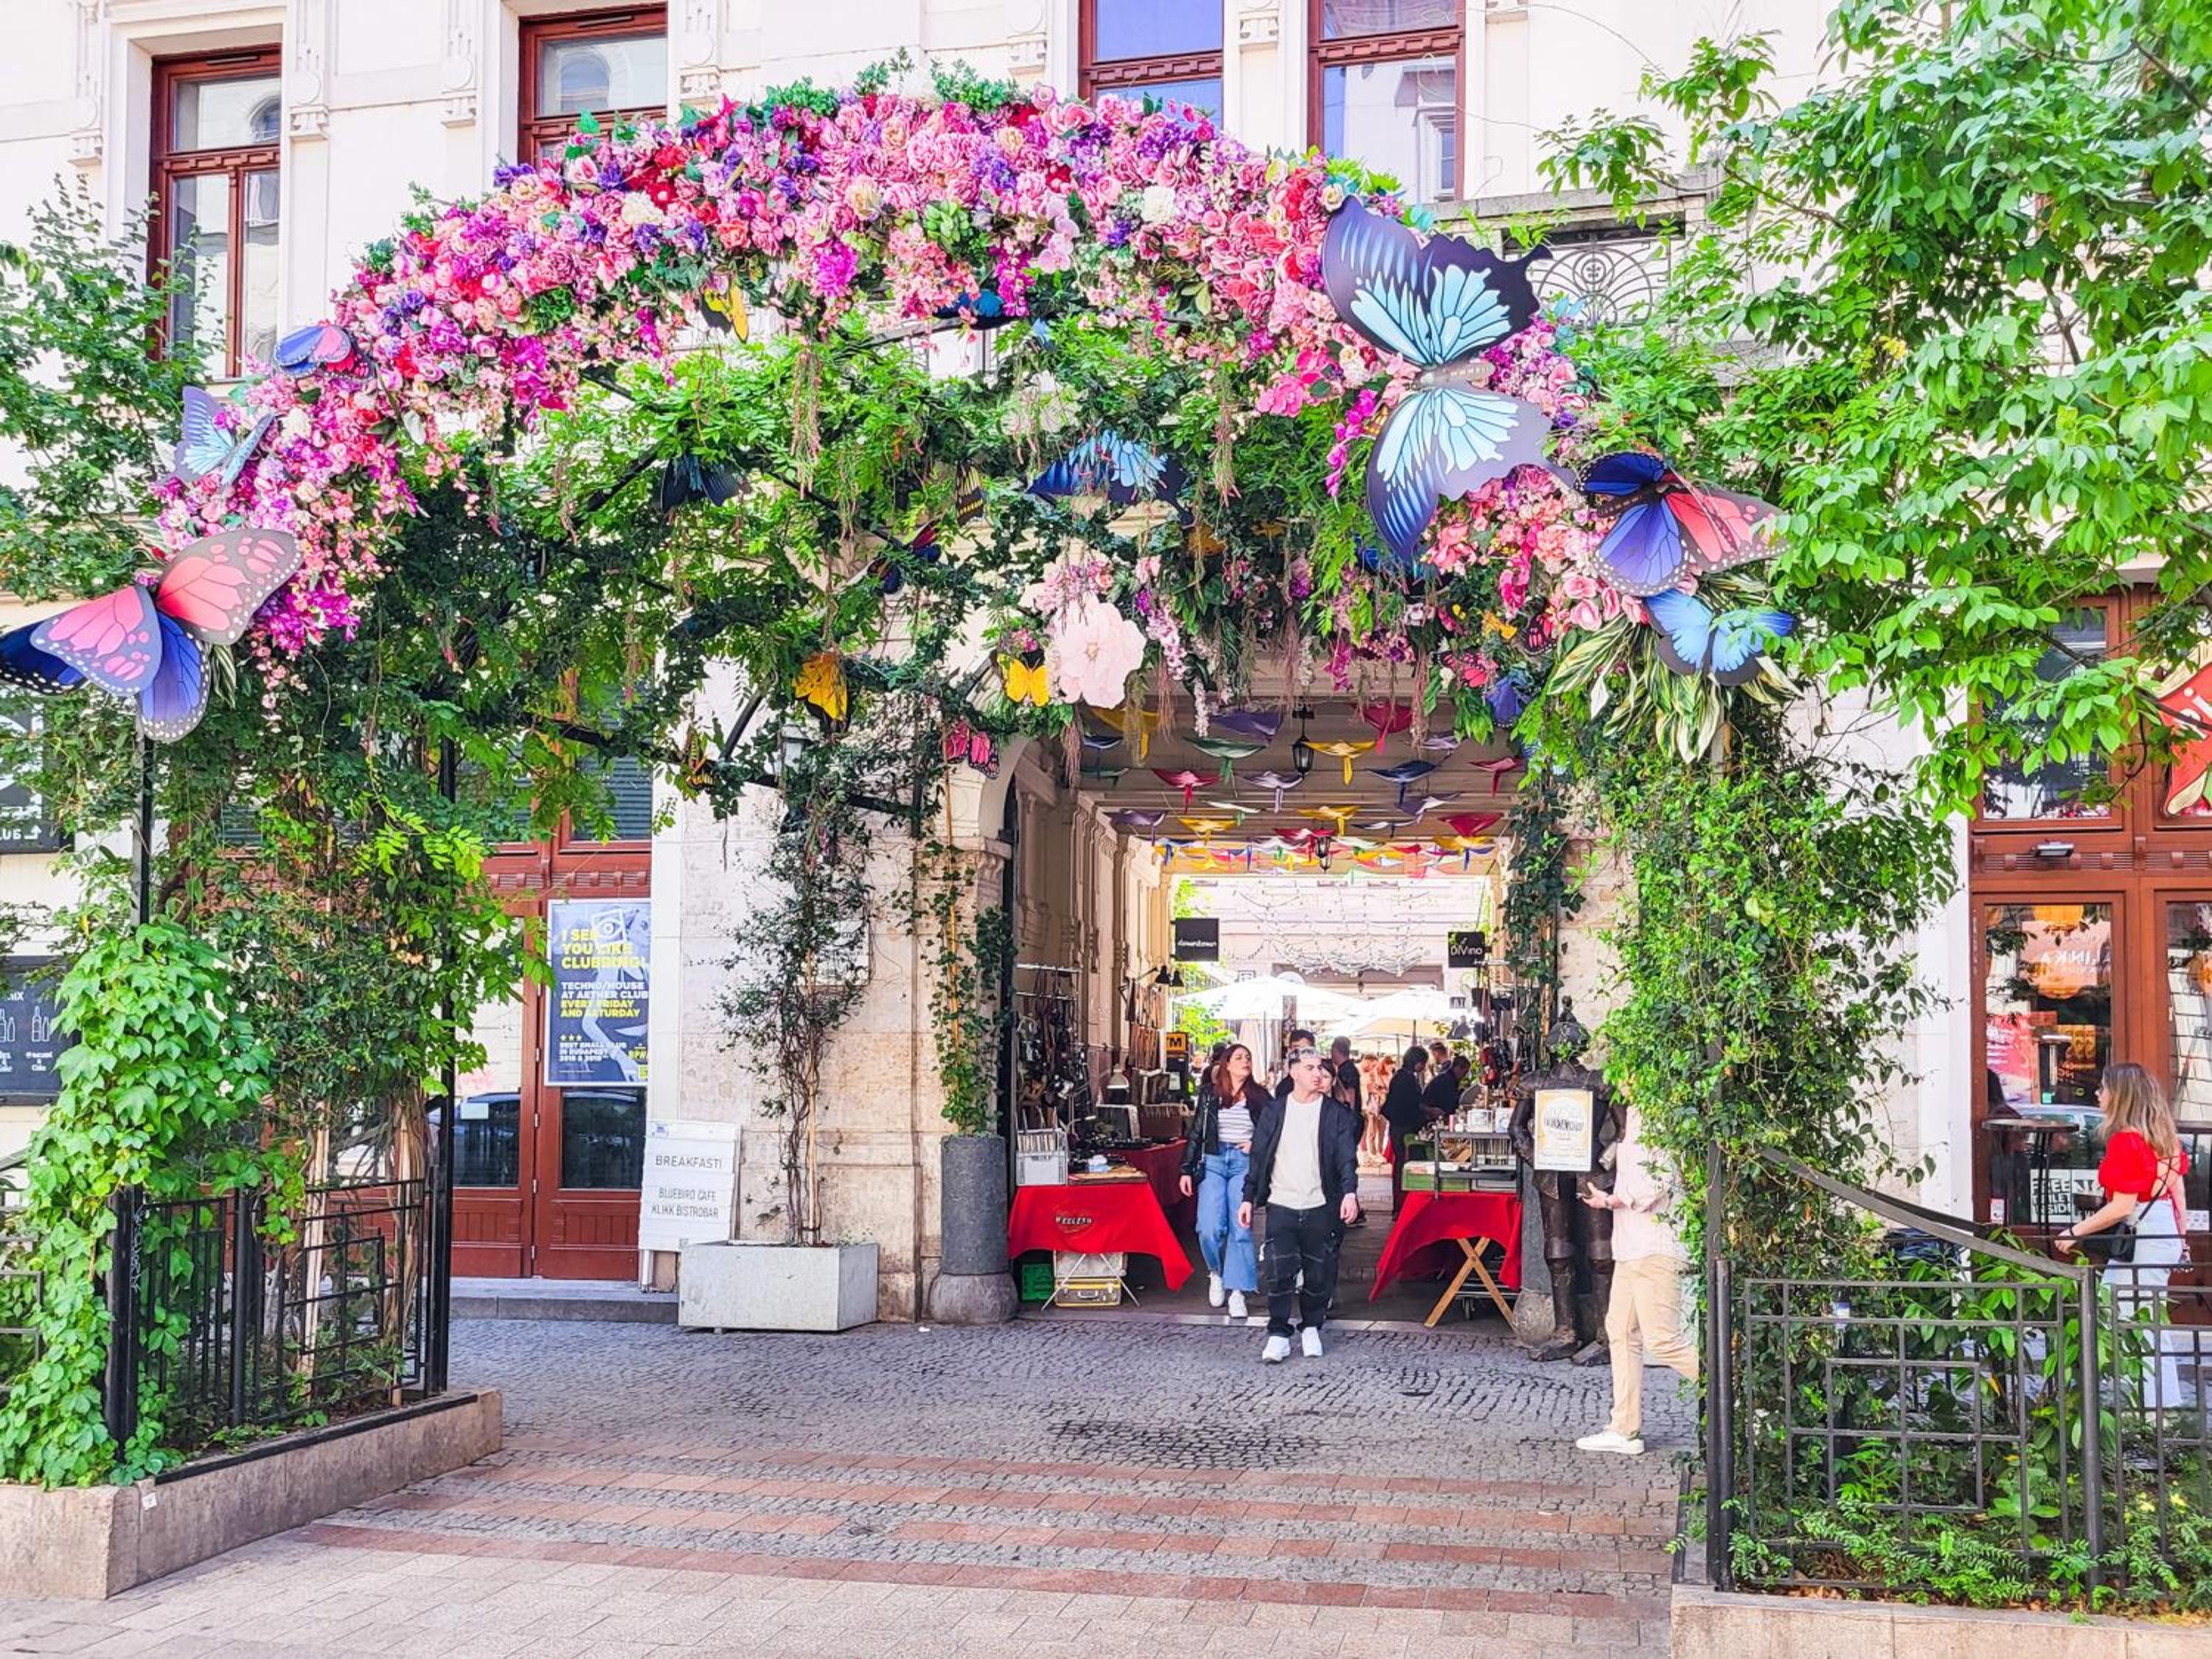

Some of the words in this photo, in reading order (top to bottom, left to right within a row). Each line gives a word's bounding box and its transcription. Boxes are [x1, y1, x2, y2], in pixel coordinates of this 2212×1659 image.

[571, 929, 599, 941] SEE
[562, 943, 593, 955] YOU
[597, 943, 633, 955] LIKE
[561, 956, 646, 969] CLUBBING!
[561, 981, 645, 990] TECHNO/HOUSE
[561, 991, 574, 999] AT
[577, 991, 618, 999] AETHER
[620, 991, 649, 999] CLUB
[561, 1000, 591, 1008] EVERY
[597, 1000, 634, 1008] FRIDAY
[561, 1009, 582, 1017] AND
[586, 1009, 641, 1017] SATURDAY
